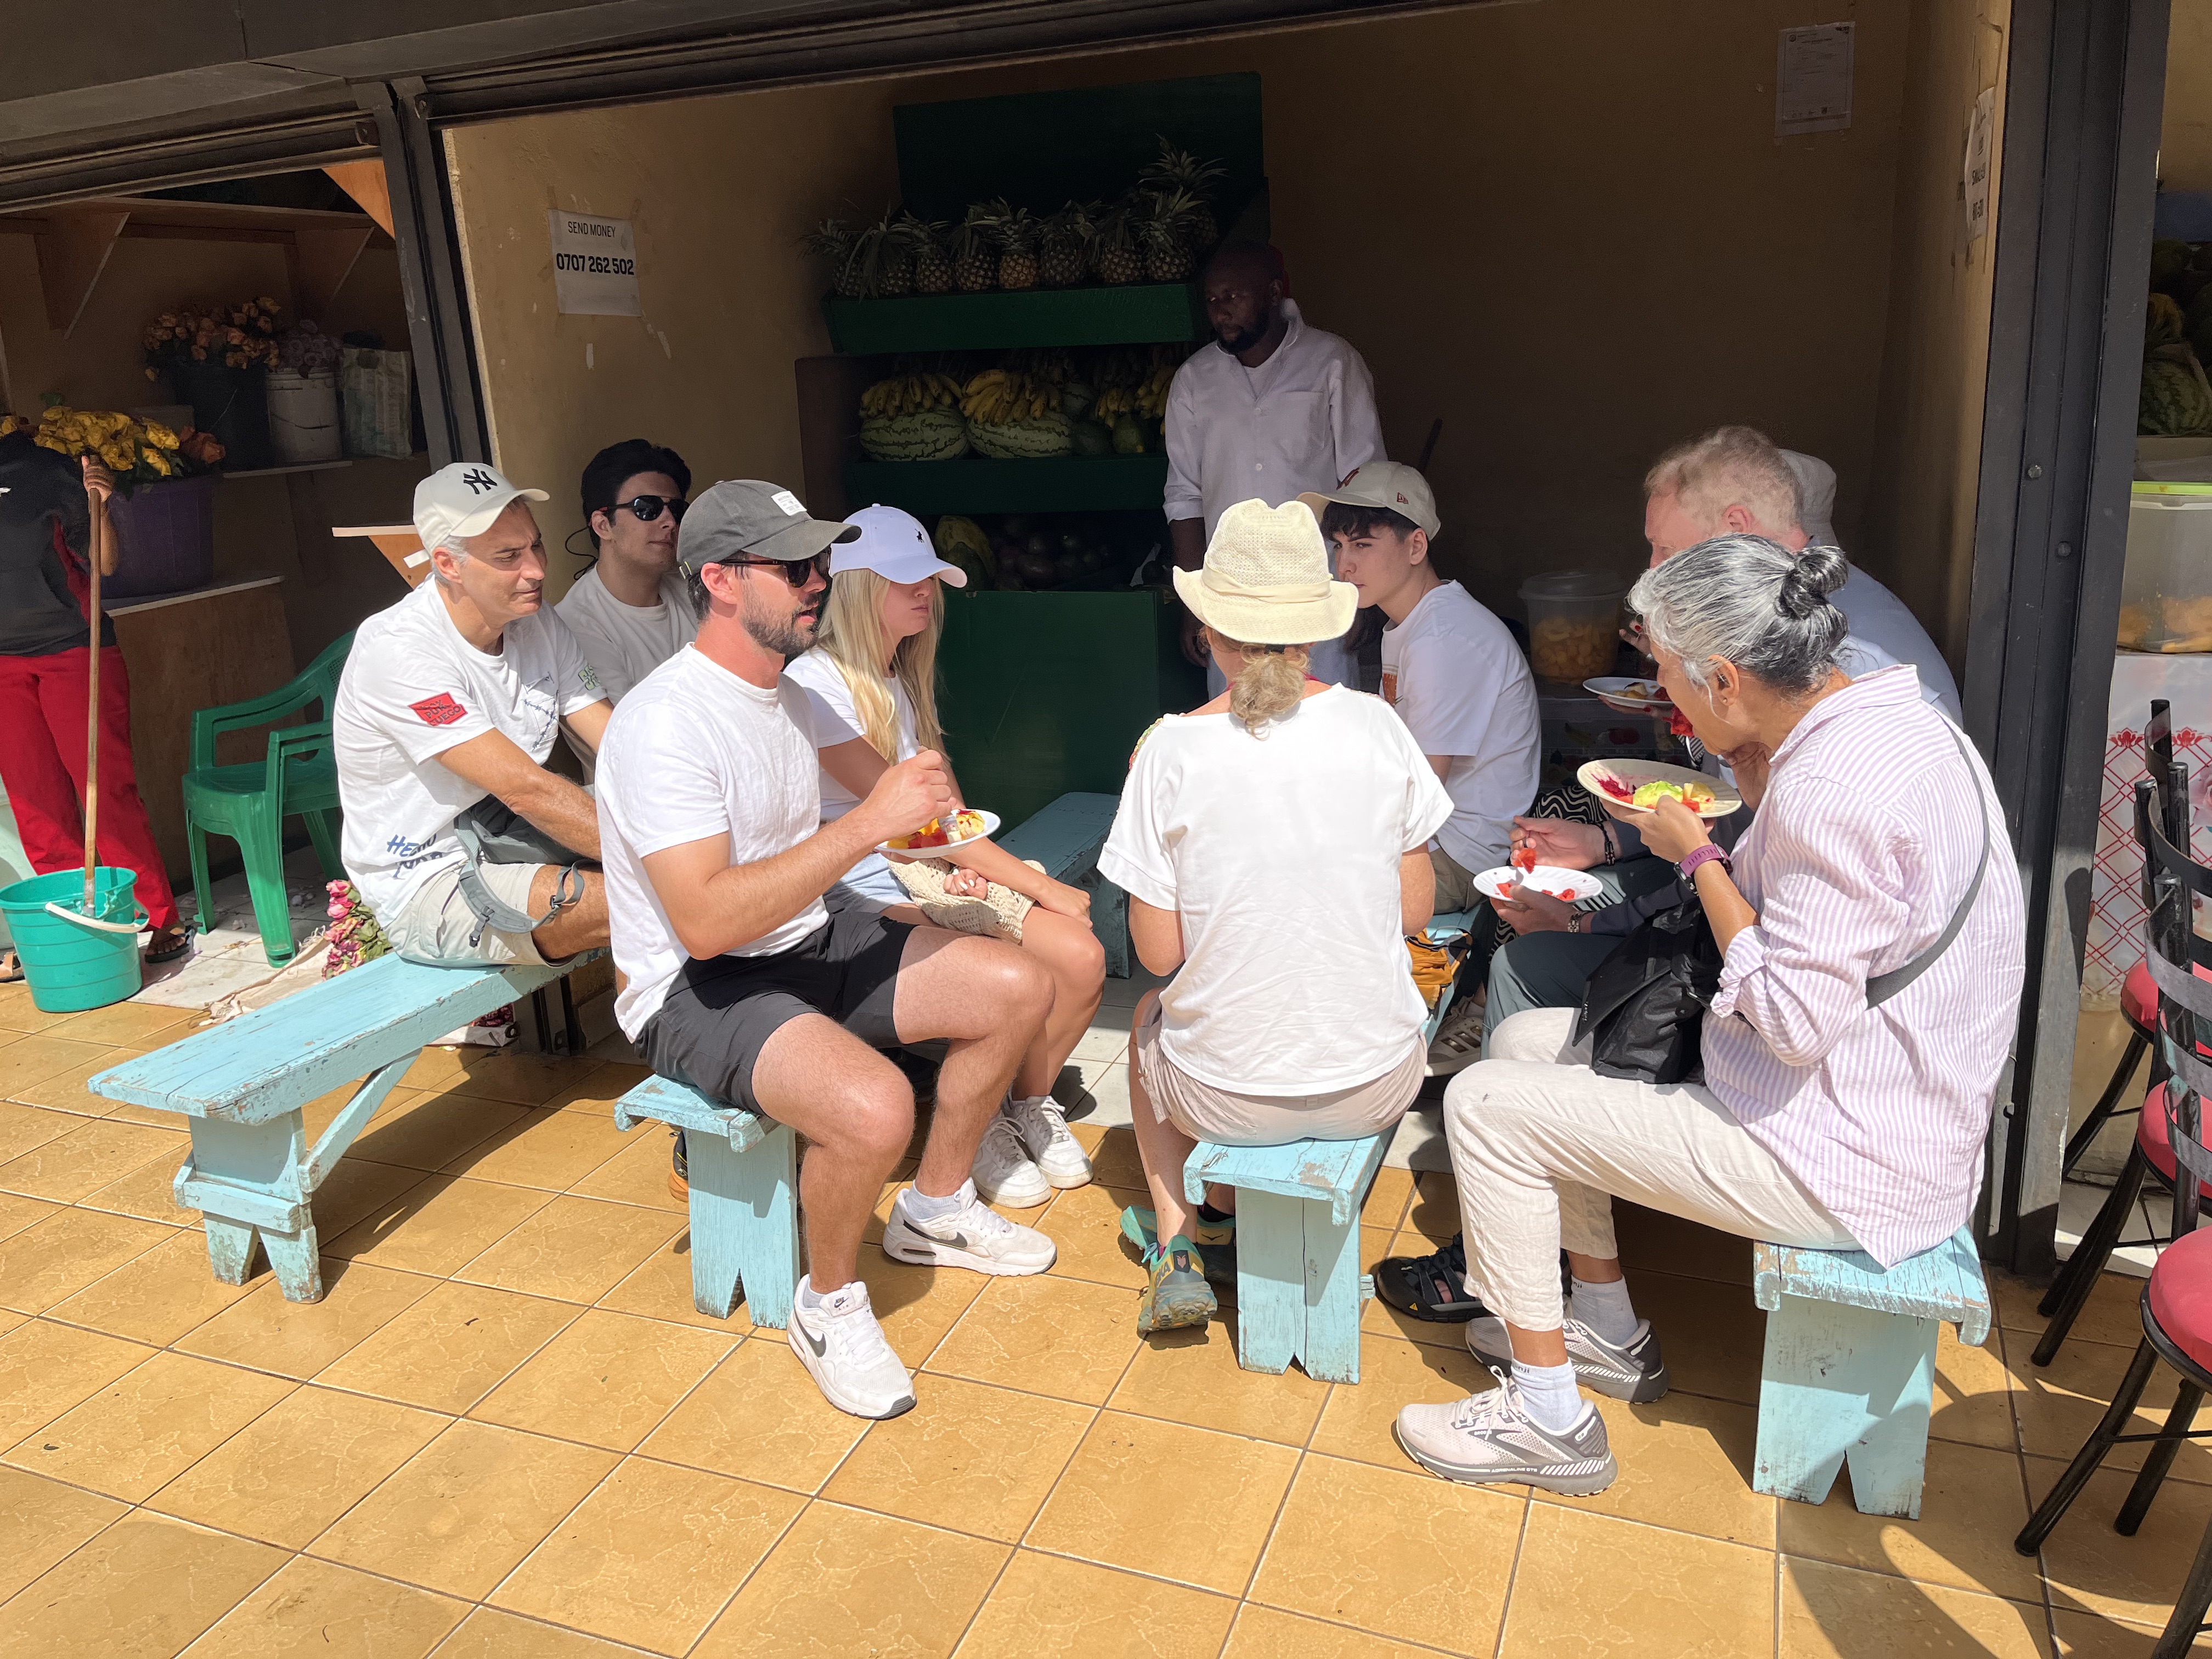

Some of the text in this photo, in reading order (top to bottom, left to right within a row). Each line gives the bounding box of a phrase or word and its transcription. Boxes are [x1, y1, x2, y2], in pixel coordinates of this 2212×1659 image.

[568, 221, 616, 238] SEND MONEY
[556, 253, 635, 275] 0707 262 502
[463, 468, 498, 495] NY
